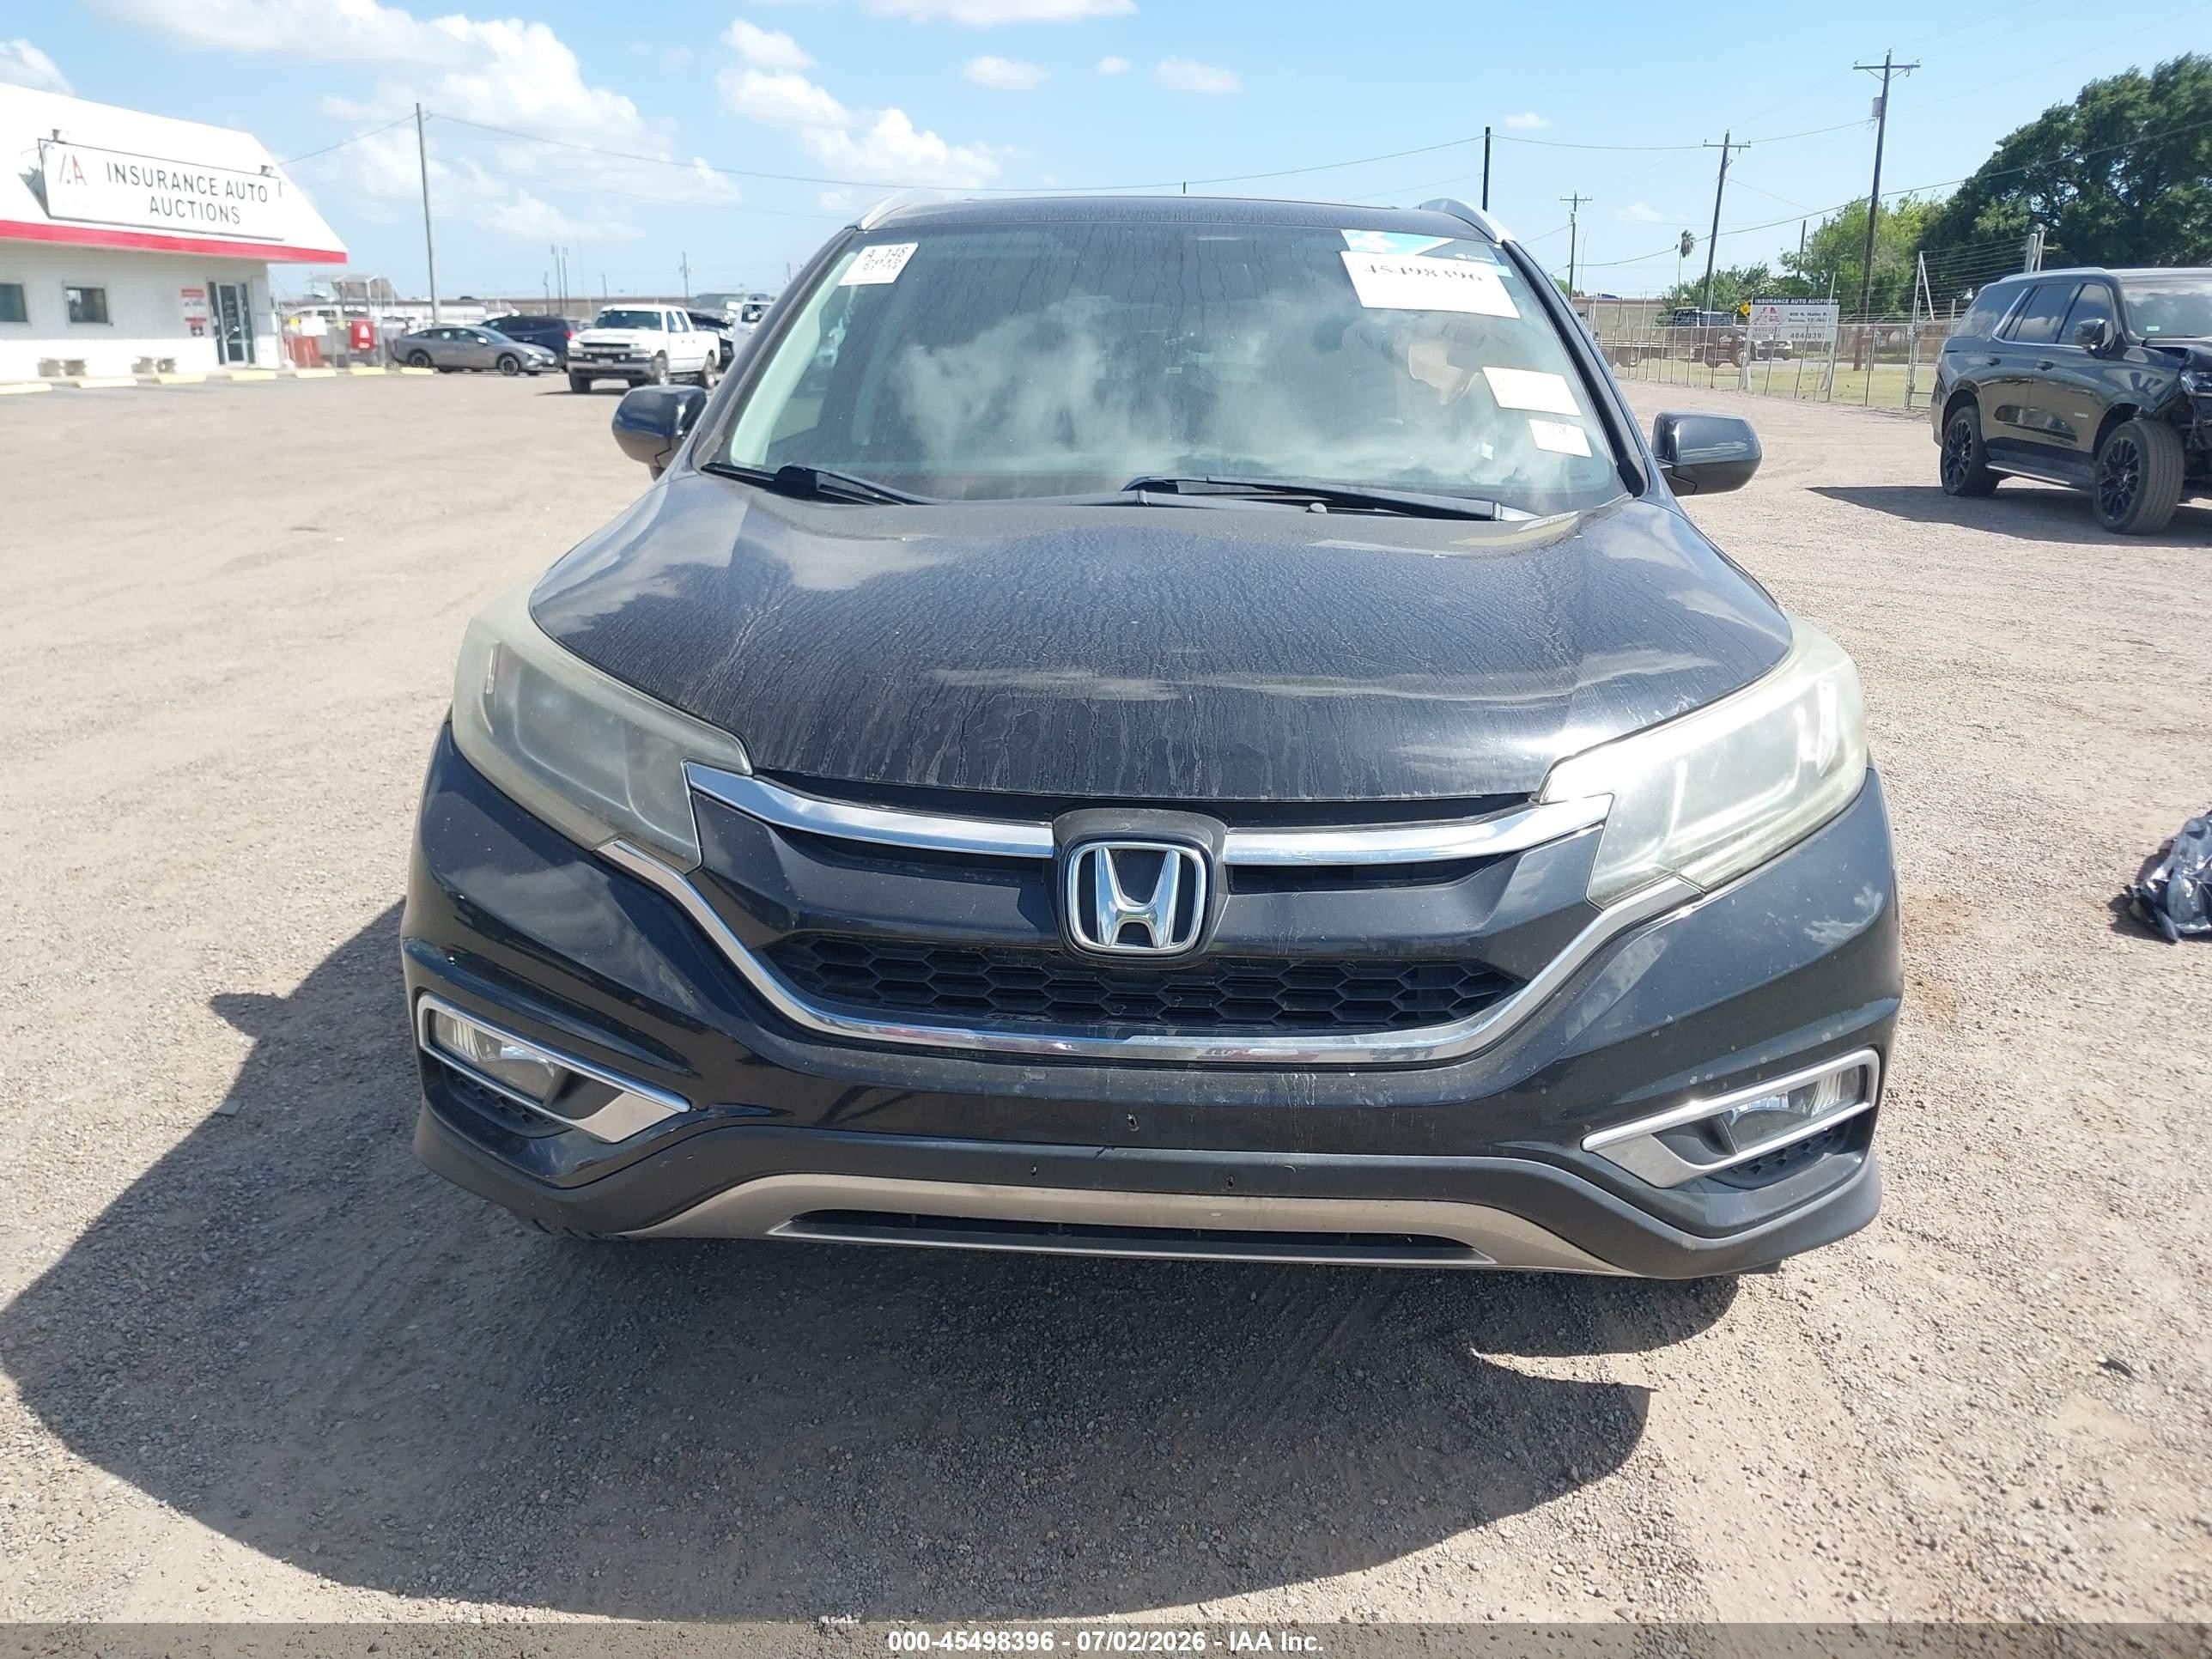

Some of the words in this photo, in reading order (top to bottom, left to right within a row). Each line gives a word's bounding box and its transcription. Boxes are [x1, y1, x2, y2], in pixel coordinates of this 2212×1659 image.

[106, 161, 219, 197] INSURANCE
[225, 180, 268, 203] AUTO
[149, 196, 240, 225] AUCTIONS
